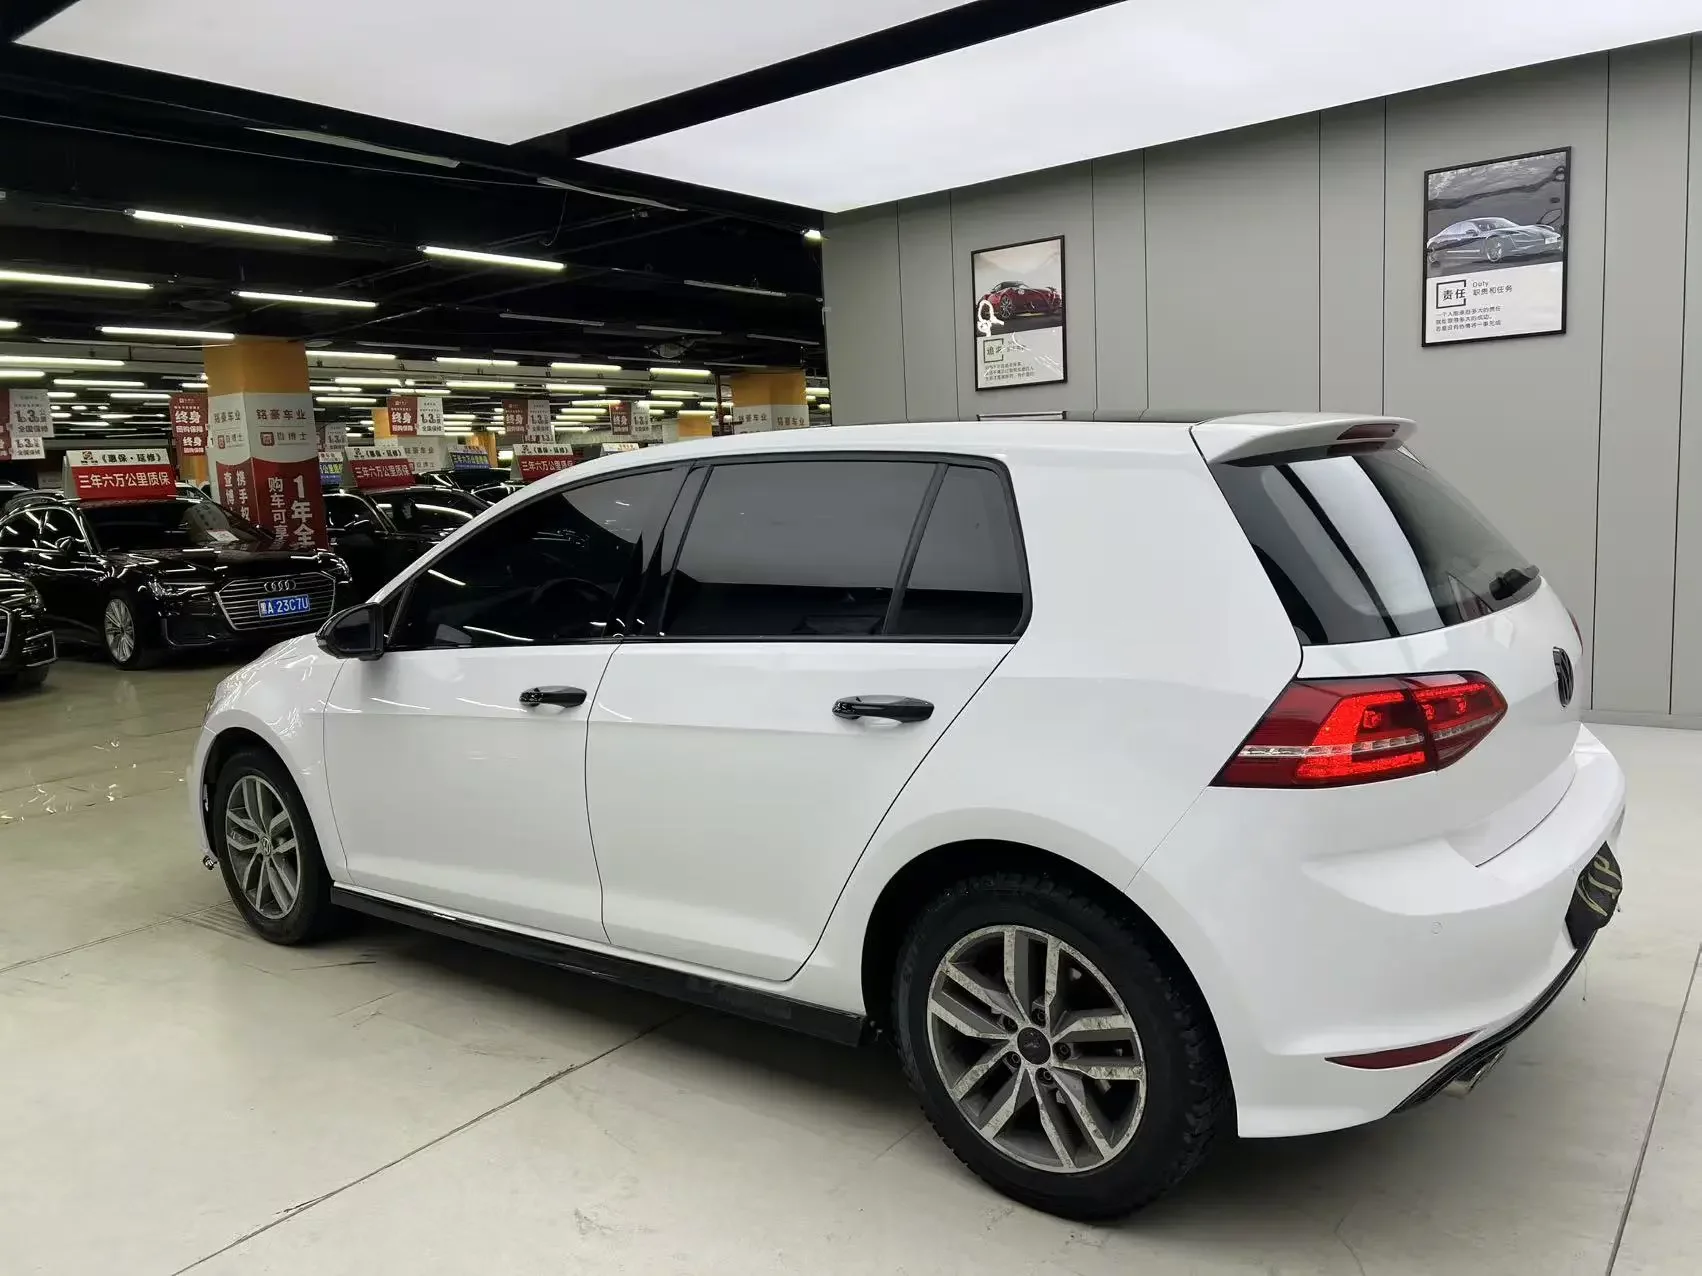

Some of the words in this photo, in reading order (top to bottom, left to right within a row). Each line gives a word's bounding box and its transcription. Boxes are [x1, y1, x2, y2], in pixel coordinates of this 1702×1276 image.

[1443, 289, 1466, 301] 责任
[175, 411, 201, 424] 终身
[392, 412, 411, 424] 终身
[355, 465, 410, 478] 三年六万公里质保
[78, 472, 170, 488] 三年六万公里质保
